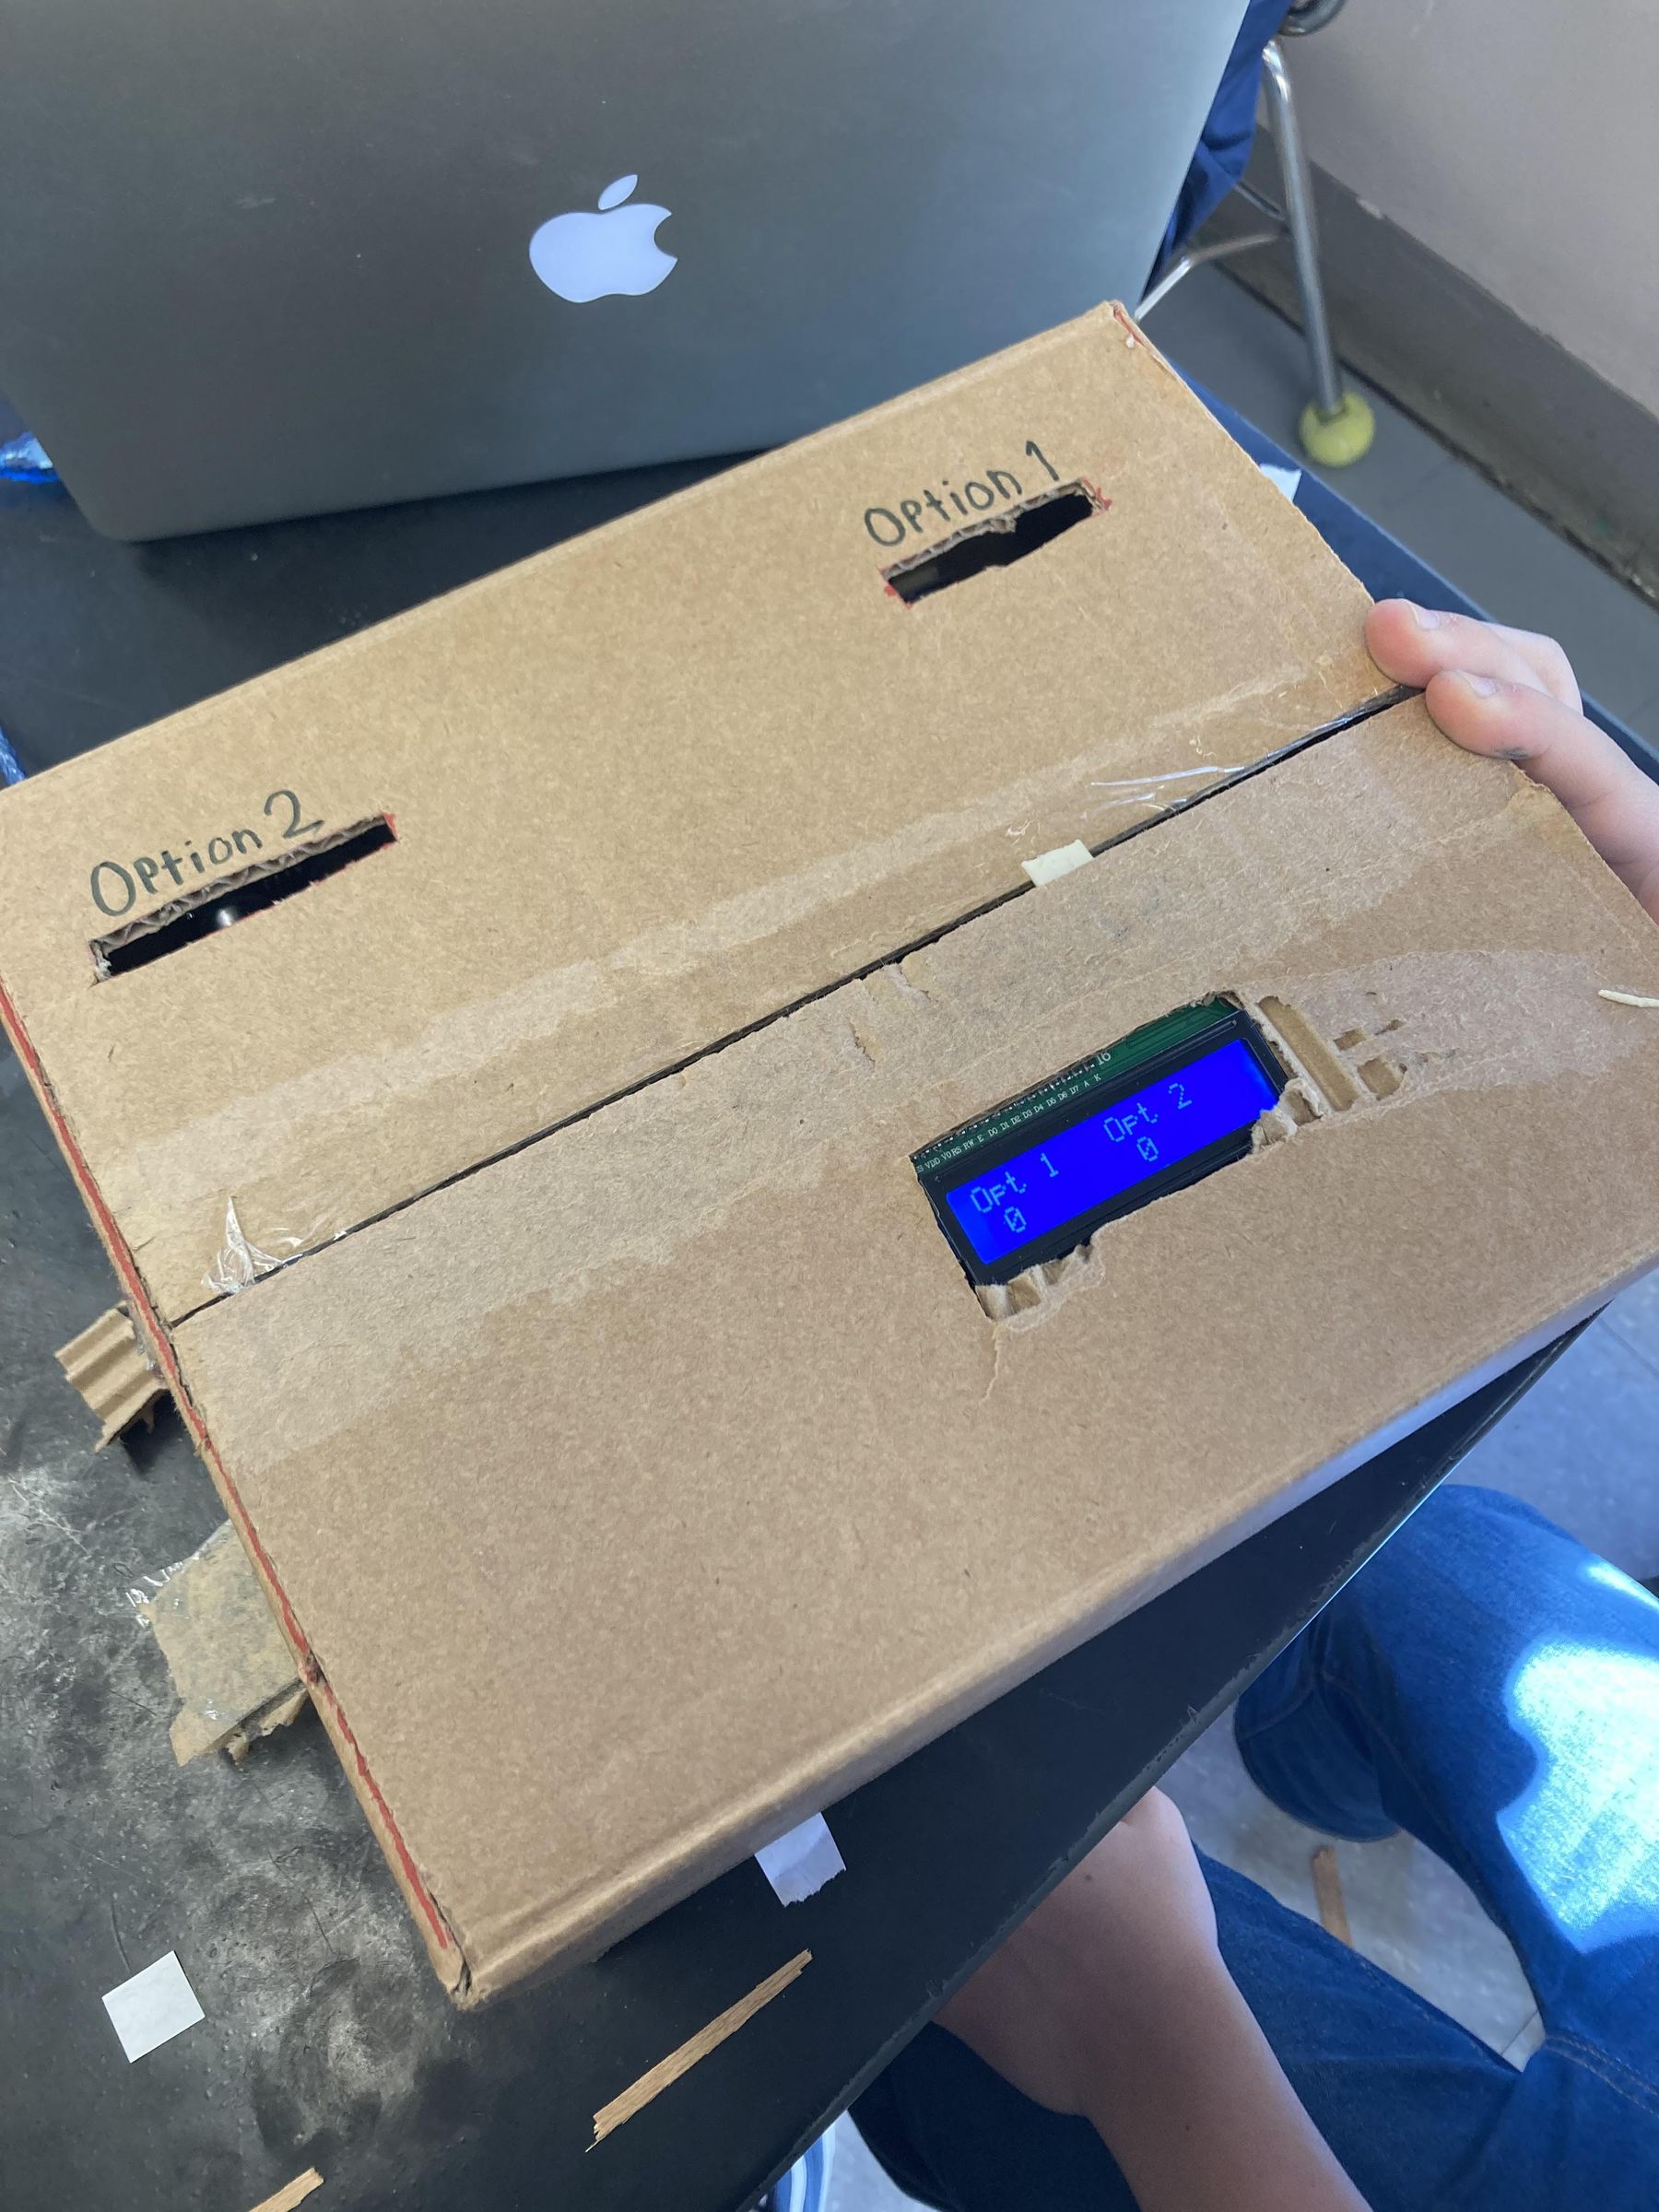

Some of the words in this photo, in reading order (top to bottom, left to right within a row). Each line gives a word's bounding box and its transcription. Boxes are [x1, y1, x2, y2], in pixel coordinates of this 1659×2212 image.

[865, 470, 1022, 547] Option
[1025, 441, 1059, 481] 1
[90, 829, 263, 916] Option
[264, 790, 324, 838] 2
[1096, 1052, 1111, 1065] 16
[924, 1157, 940, 1169] VDD
[951, 1146, 962, 1156] RS
[963, 1139, 974, 1150] RW
[977, 1134, 984, 1143] E
[1000, 1122, 1009, 1131] D1
[1010, 1116, 1022, 1125] D2
[1022, 1110, 1033, 1119] D3
[1033, 1104, 1044, 1113] D4
[1069, 1085, 1079, 1095] D7
[1093, 1074, 1102, 1082] K
[971, 1171, 1027, 1213] Opt
[1041, 1153, 1059, 1178] 1
[1103, 1102, 1158, 1142] Opt
[1169, 1083, 1193, 1110] 2
[1004, 1206, 1027, 1233] 0
[1136, 1136, 1159, 1161] 0
